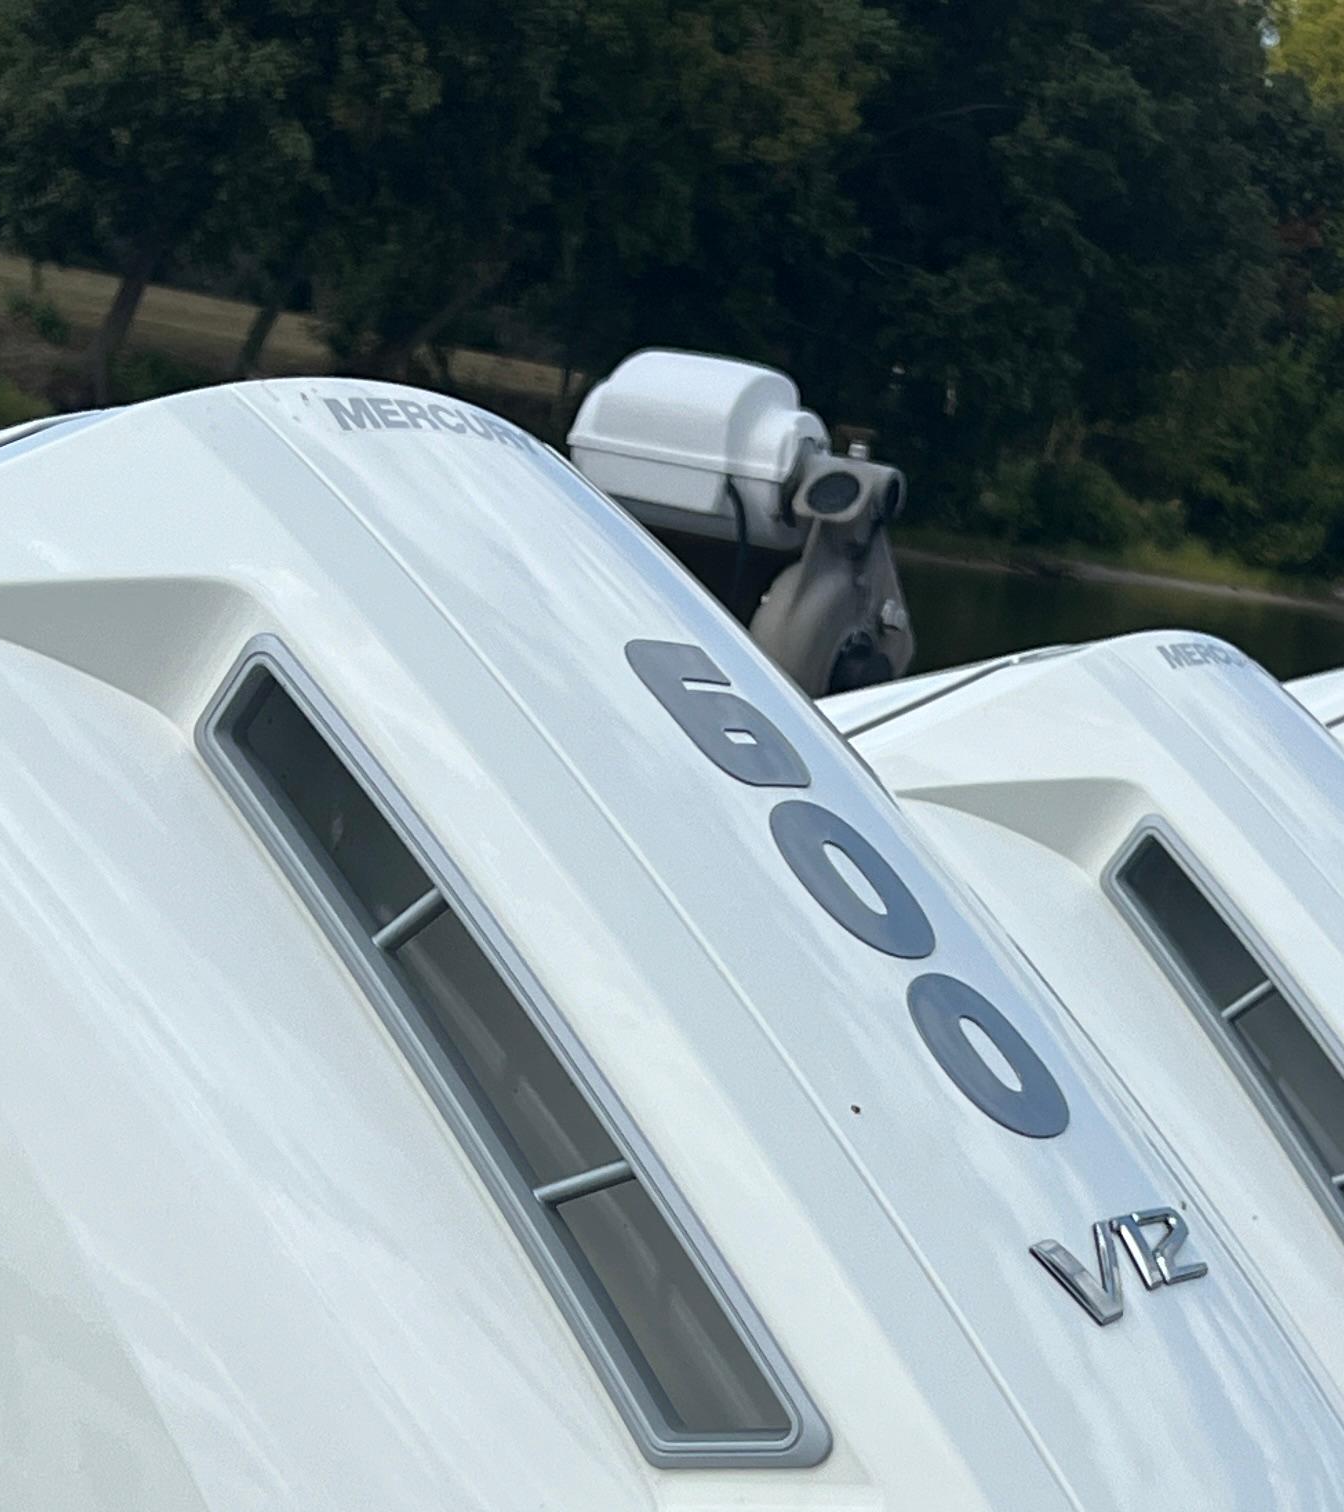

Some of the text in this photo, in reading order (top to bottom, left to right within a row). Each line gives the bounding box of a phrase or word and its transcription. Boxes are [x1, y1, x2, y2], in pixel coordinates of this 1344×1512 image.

[323, 397, 538, 454] MERCURY
[624, 638, 1071, 1139] 600
[1029, 1206, 1209, 1326] V12
